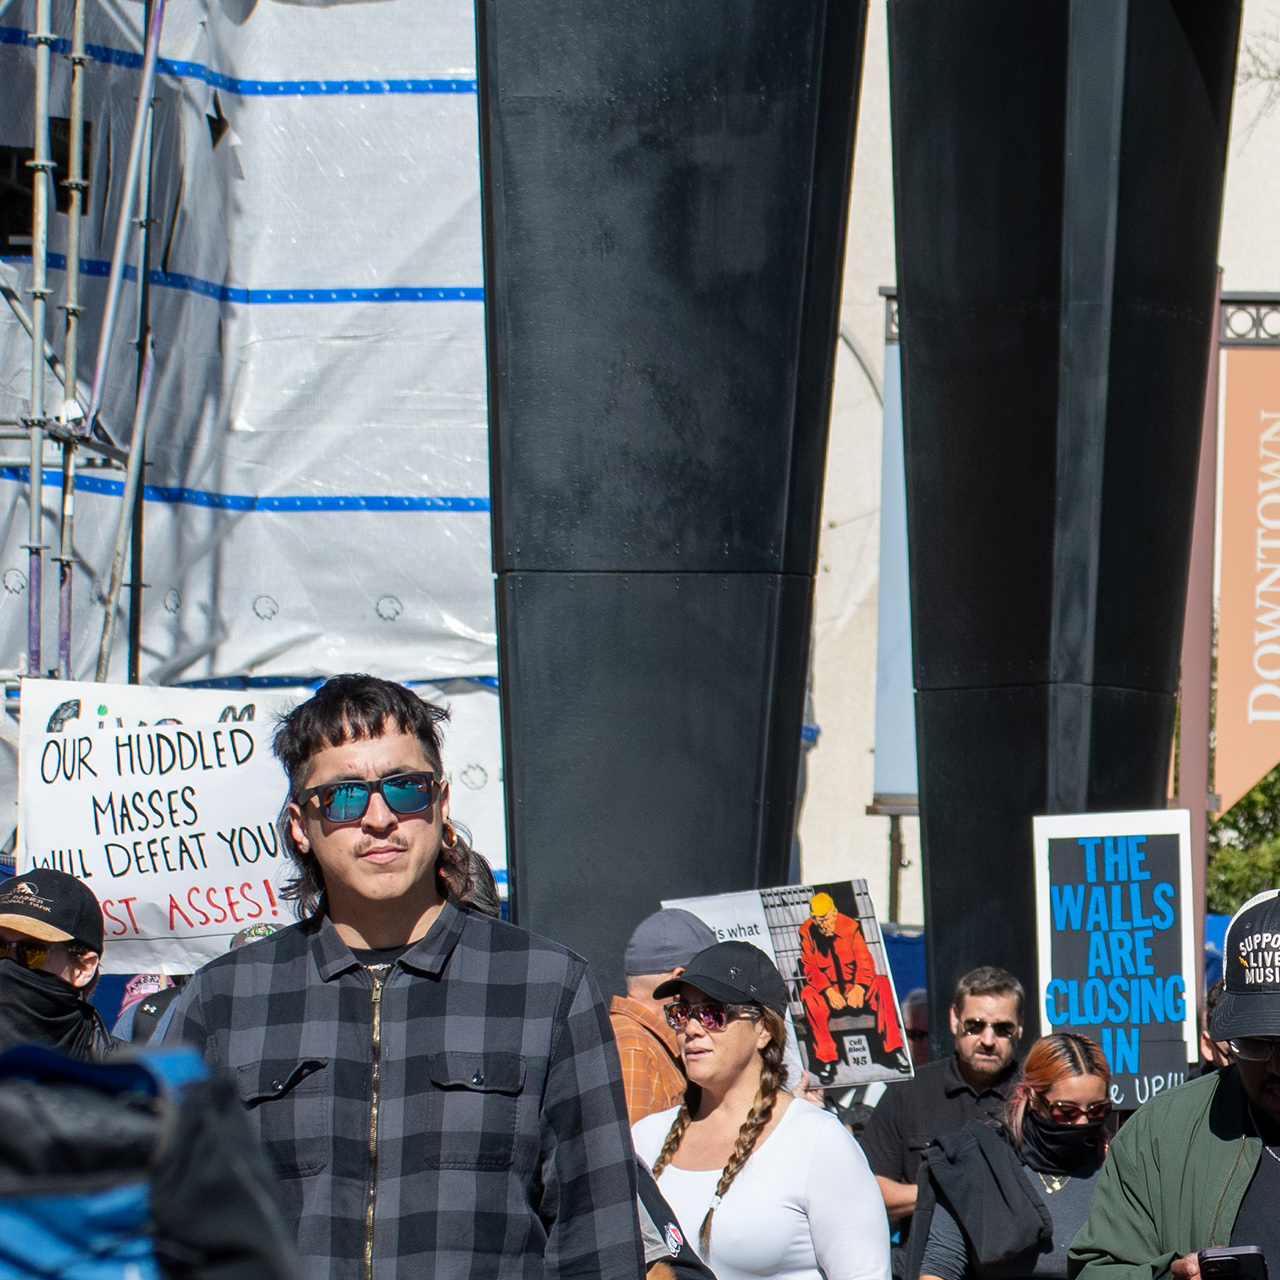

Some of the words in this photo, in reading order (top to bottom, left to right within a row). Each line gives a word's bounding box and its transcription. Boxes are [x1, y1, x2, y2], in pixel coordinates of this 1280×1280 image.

[41, 735, 98, 785] OUR
[115, 728, 255, 777] HUDDLED
[92, 785, 199, 837] MASSES
[104, 832, 208, 878] DEFEAT
[1077, 834, 1151, 883] THE
[168, 879, 279, 931] ASSES!
[1050, 881, 1175, 931] WALLS
[727, 923, 761, 939] what
[1087, 929, 1154, 978] ARE
[1045, 974, 1187, 1026] CLOSING
[1101, 1027, 1140, 1075] IN
